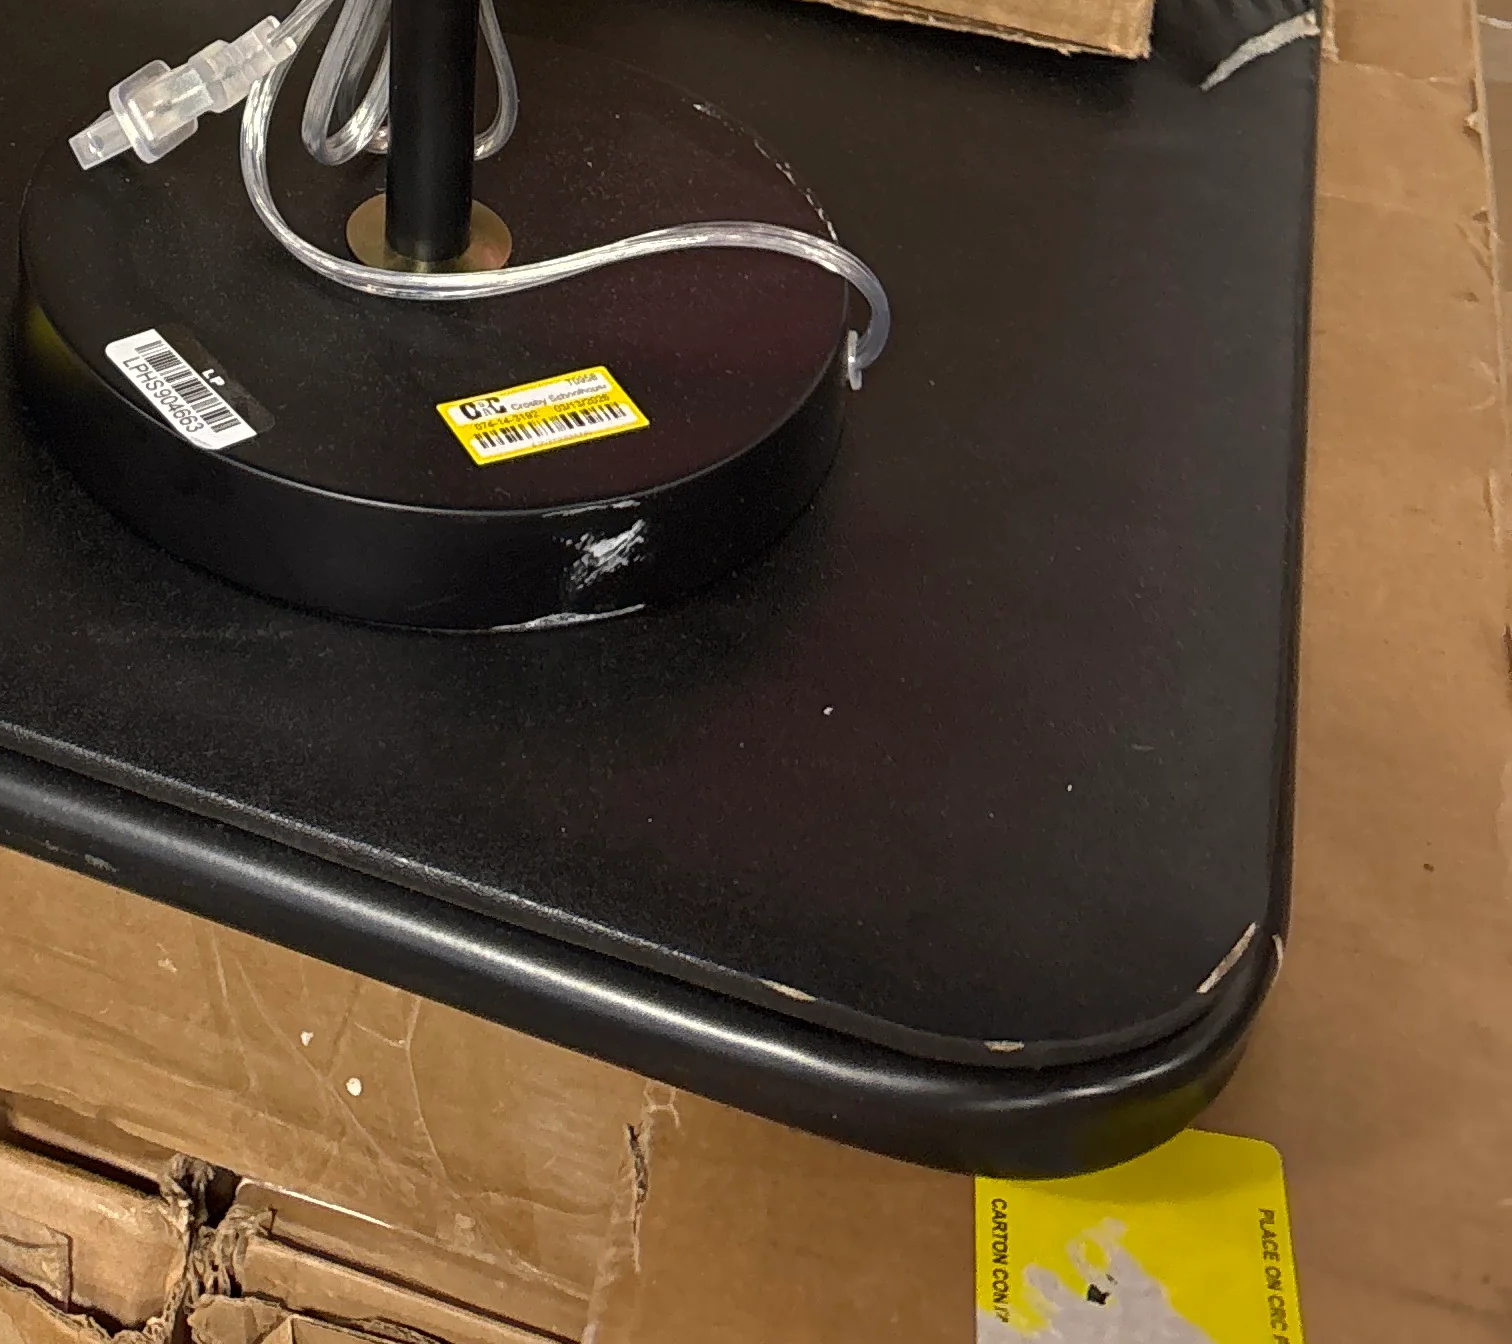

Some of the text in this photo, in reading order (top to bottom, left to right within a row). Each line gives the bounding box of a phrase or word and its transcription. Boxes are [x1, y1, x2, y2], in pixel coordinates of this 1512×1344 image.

[123, 357, 204, 432] LPHS904663
[202, 369, 226, 386] LP
[991, 1198, 1009, 1323] CARTON CON
[1258, 1208, 1279, 1262] PLACE
[1264, 1266, 1282, 1291] ON
